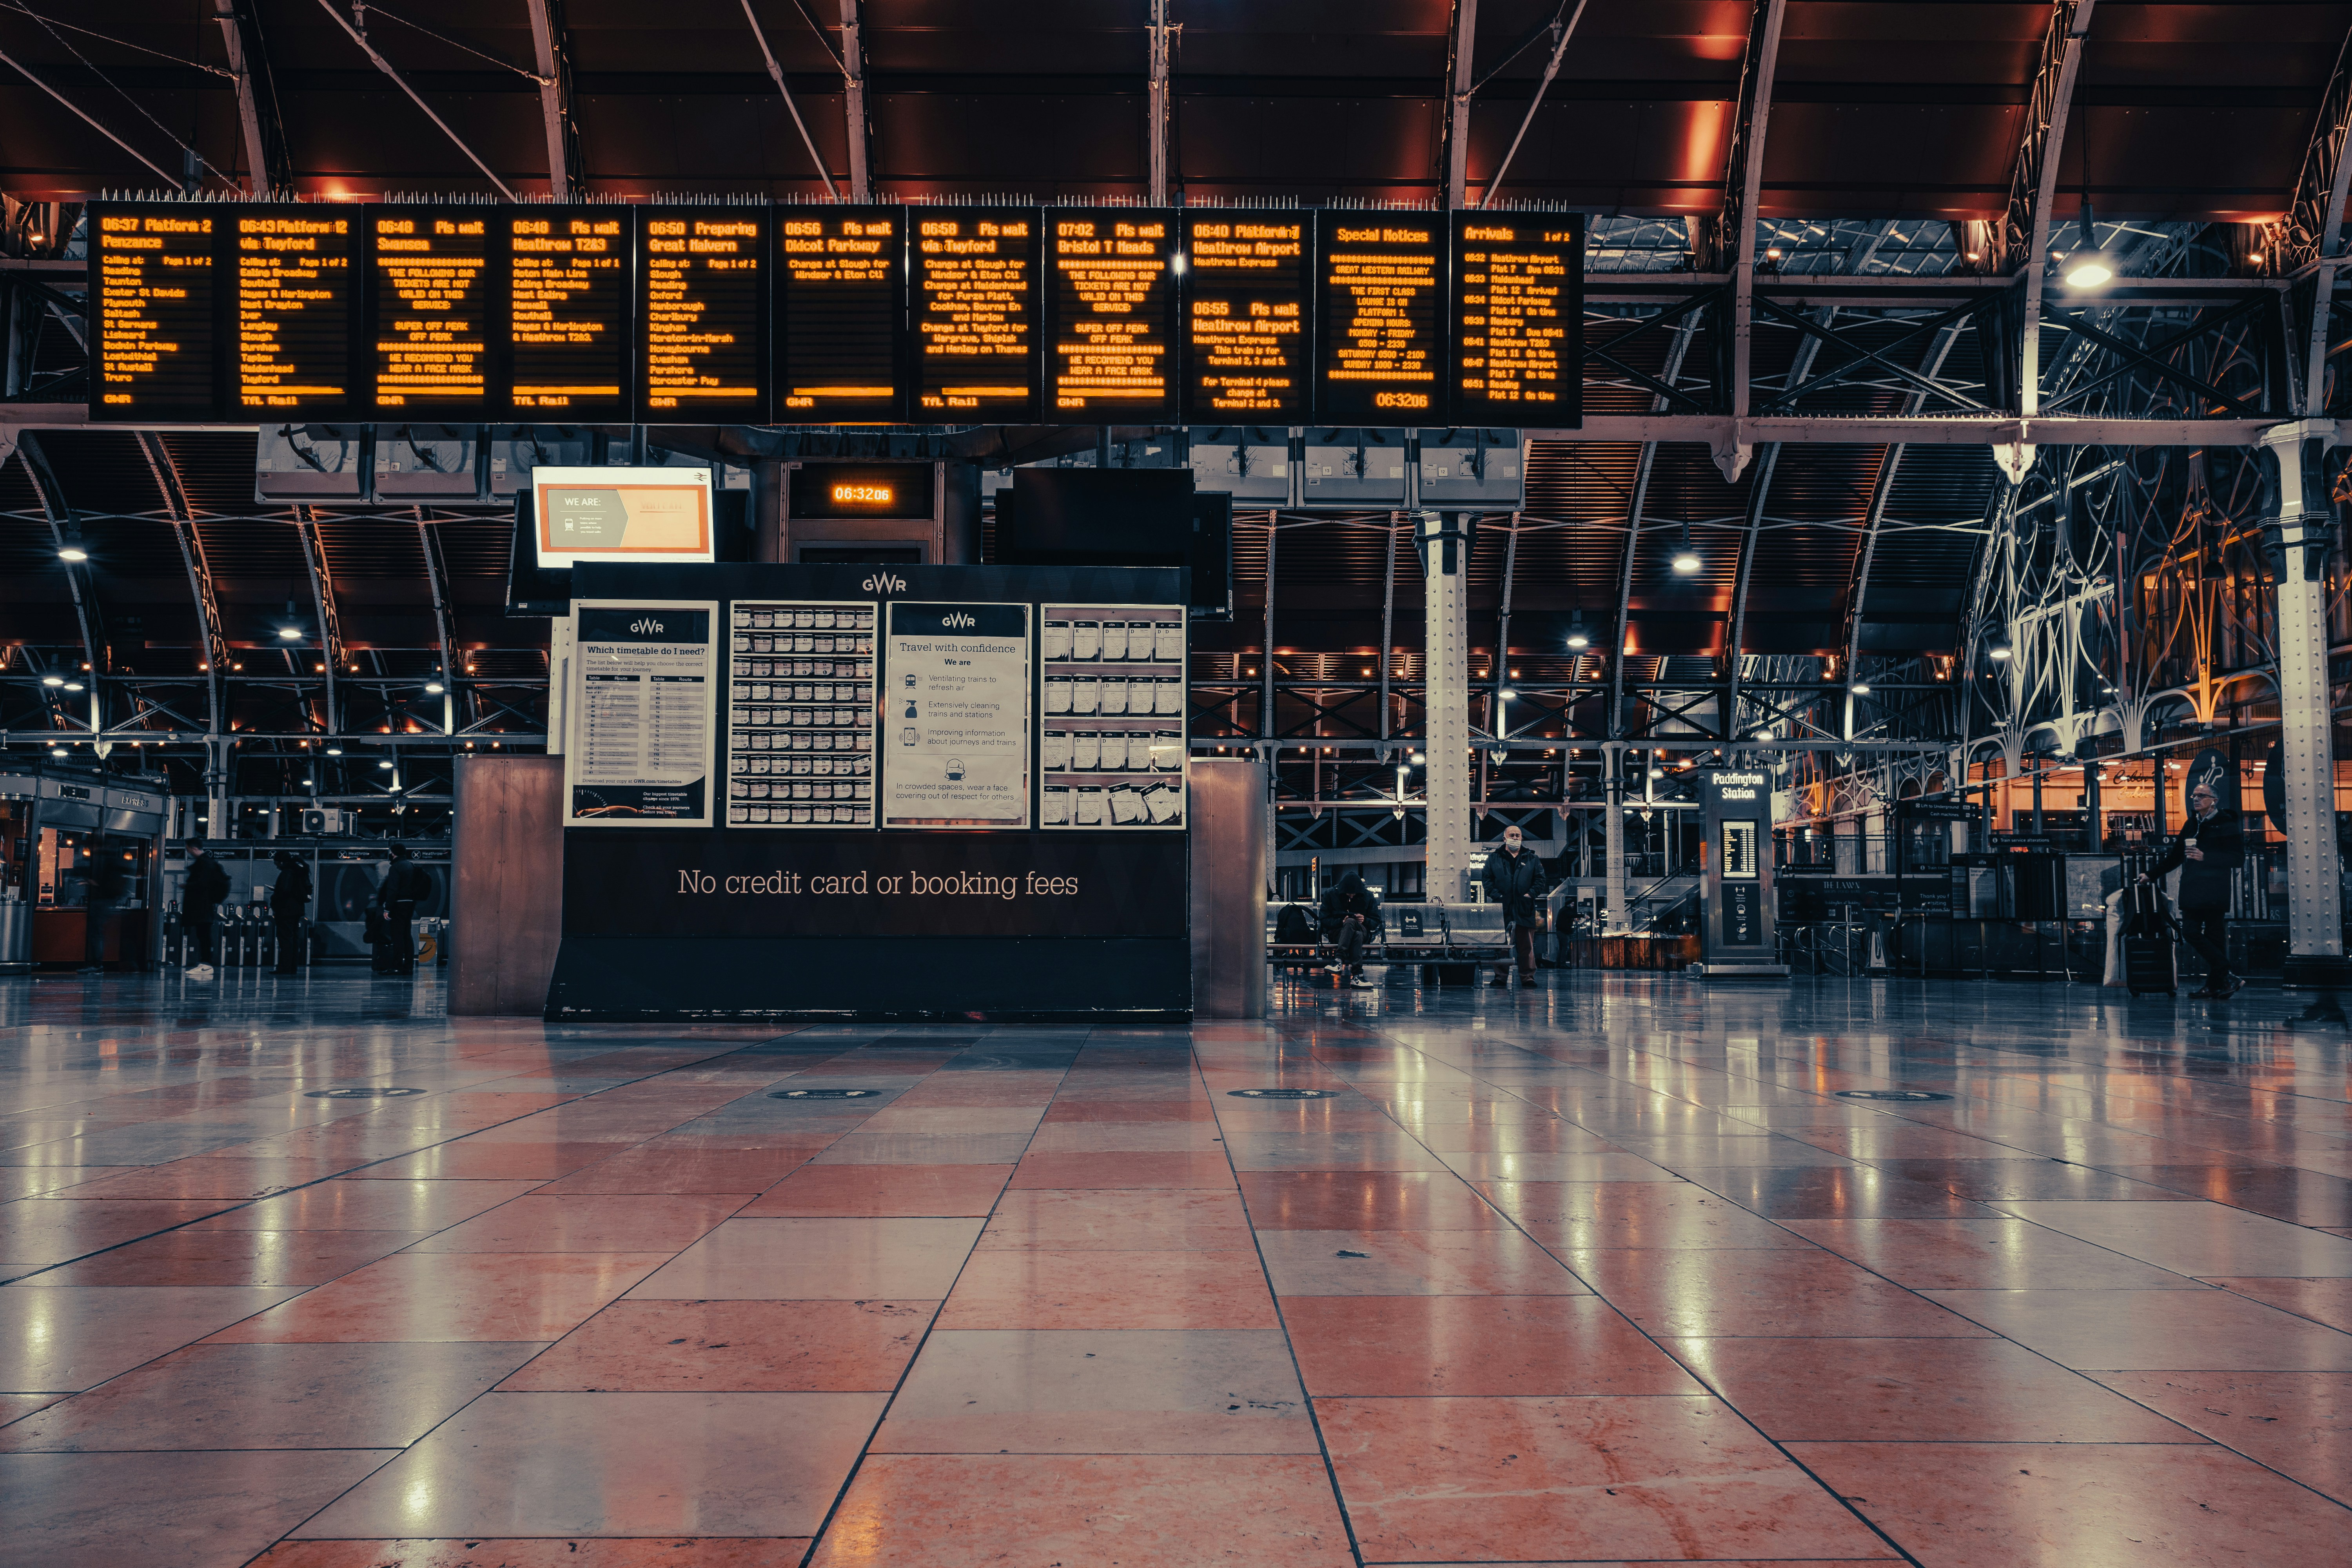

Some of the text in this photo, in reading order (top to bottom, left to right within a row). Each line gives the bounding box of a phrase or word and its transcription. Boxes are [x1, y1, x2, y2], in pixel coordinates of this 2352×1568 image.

[102, 218, 211, 232] 06:37 Platform 2
[241, 220, 277, 232] 06:43
[378, 220, 484, 234] 06:48 Pls wait
[514, 221, 619, 234] 06:48 Pls wait
[650, 222, 756, 236] 06:50 Preparing
[786, 222, 891, 235] 06:56 Pls wait
[922, 223, 1028, 236] 06:58 Pls wait
[1058, 223, 1164, 237] 07:02 Pls wait
[1194, 225, 1229, 238] 06:40
[1338, 229, 1428, 242] Special Notices
[1465, 227, 1513, 240] Arrivals
[1552, 233, 1561, 241] of
[1564, 233, 1570, 241] 2
[102, 235, 162, 249] Penzance
[377, 237, 430, 250] Swansea
[513, 238, 572, 251] Heathrow
[649, 239, 737, 252] Great Malvern
[786, 239, 880, 253] Didcot Parkway
[1058, 240, 1154, 254] Bristol T Meads
[1193, 241, 1300, 256] Heathrow Airport
[1194, 258, 1277, 267] Heathrow Express
[103, 267, 141, 276] Reading
[1069, 271, 1156, 280] THE FOLLOWING GWR
[1362, 266, 1395, 274] WESTERN
[1397, 267, 1429, 275] RAILWAY
[103, 277, 142, 285] Taunton
[240, 279, 280, 287] Southall
[650, 281, 686, 290] Reading
[650, 291, 682, 299] Oxford
[1194, 302, 1299, 316] 06:55 Pls wait
[395, 321, 468, 330] SUPER OFF PEAK
[1193, 319, 1299, 333] Heathrow Airport
[241, 332, 272, 341] Slough
[105, 373, 132, 381] Truro
[1489, 380, 1519, 389] Reading
[104, 394, 131, 403] GWR
[241, 396, 297, 405] TfL Rail
[377, 396, 404, 405] GWR
[513, 396, 568, 405] TfL Rail
[650, 397, 676, 406] GWR
[787, 397, 813, 407] GWR
[922, 397, 977, 407] TfL Rail
[1058, 398, 1084, 407] GWR
[863, 571, 906, 594] GWR
[631, 618, 663, 634] GWR
[942, 611, 975, 628] GWR
[961, 644, 1015, 653] confidence
[929, 701, 968, 710] Extensively
[1713, 773, 1764, 786] Paddington
[1722, 786, 1755, 799] Station
[678, 870, 1077, 899] No credit card or booking fees
